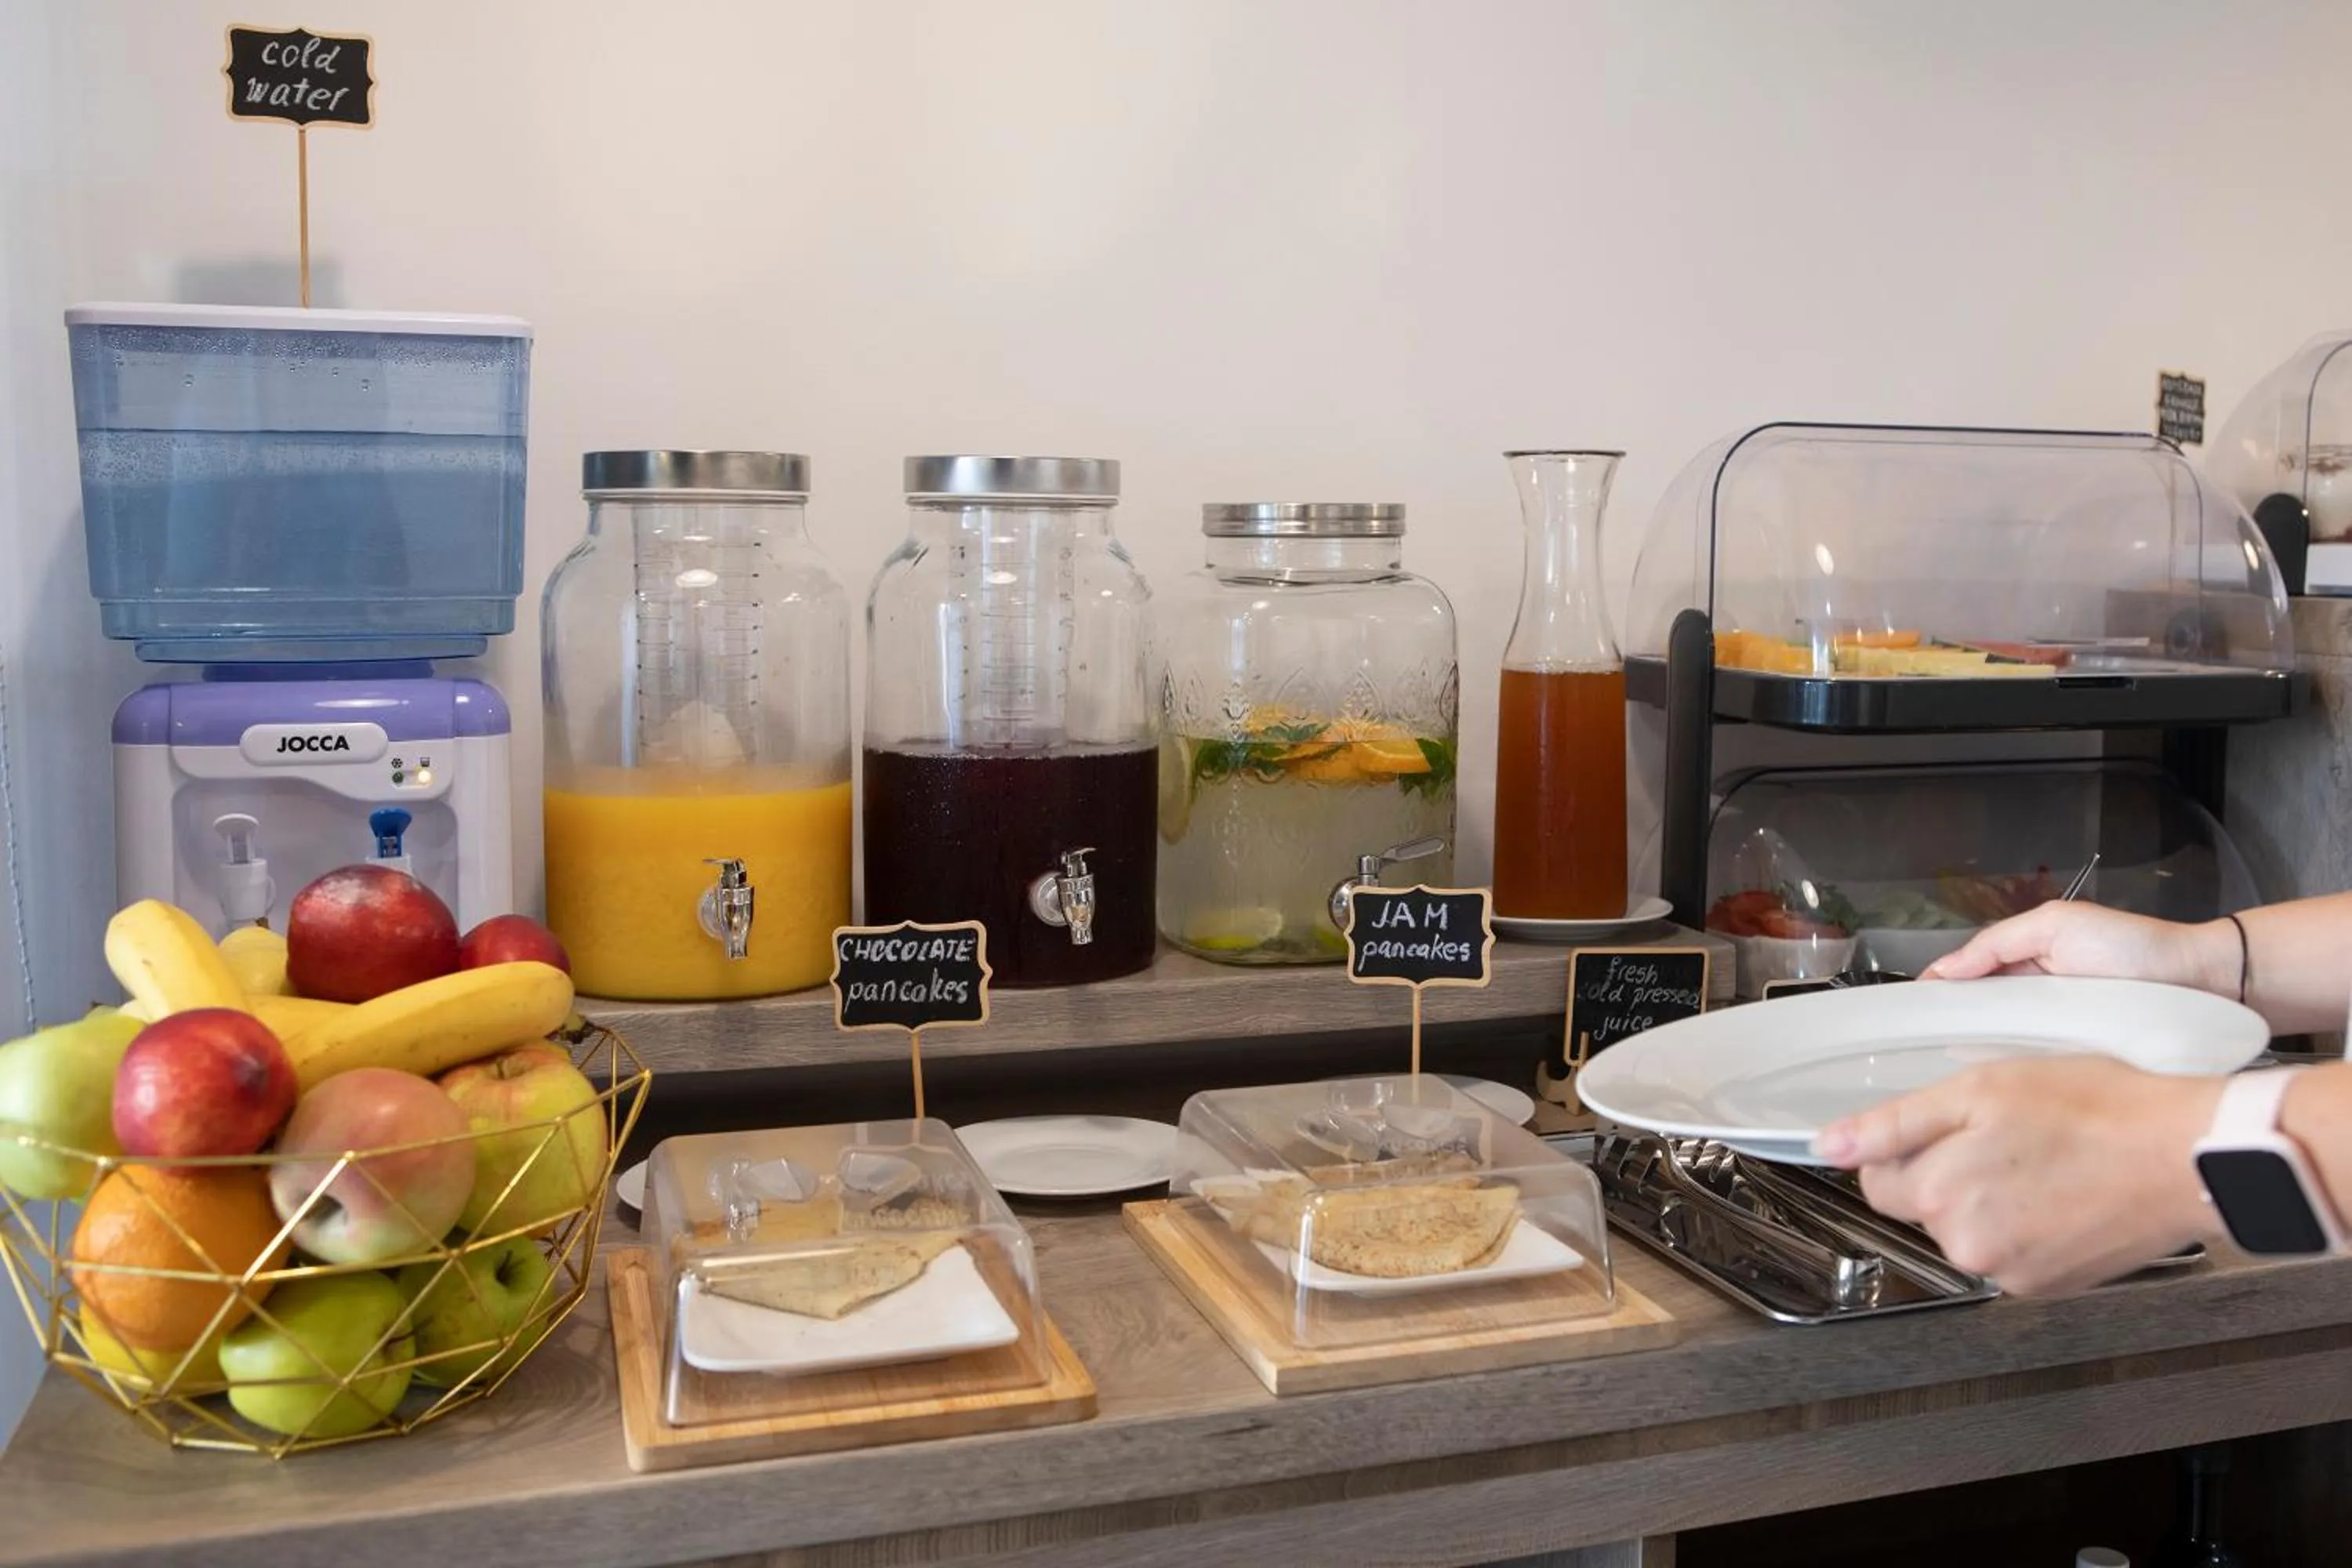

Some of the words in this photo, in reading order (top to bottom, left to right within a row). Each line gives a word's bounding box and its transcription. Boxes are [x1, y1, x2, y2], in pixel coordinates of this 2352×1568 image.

[261, 38, 341, 74] cold
[245, 77, 350, 111] water
[276, 735, 350, 753] JOCCA
[1371, 900, 1449, 931] JAM
[839, 938, 976, 962] CHOCOLATE
[1357, 933, 1472, 973] pancakes
[1607, 955, 1658, 985] fresh
[843, 967, 969, 1014] pancakes
[1577, 980, 1624, 1003] old
[1629, 986, 1704, 1012] pressed
[1593, 1013, 1653, 1037] juice
